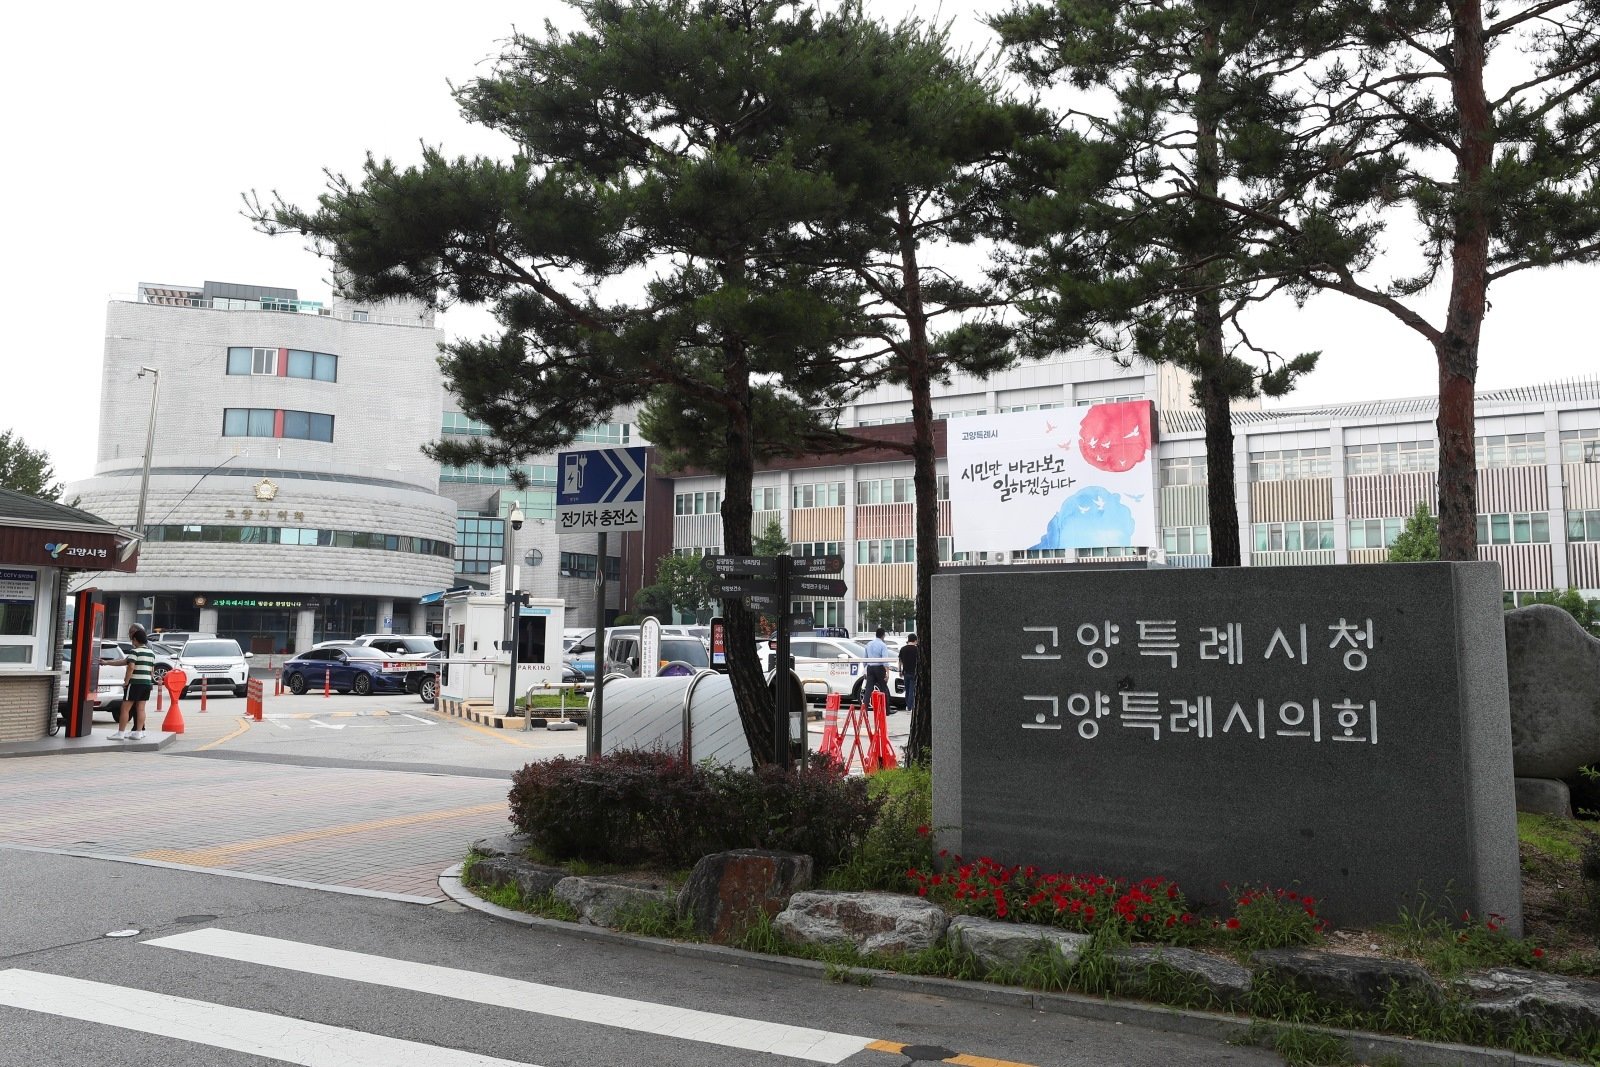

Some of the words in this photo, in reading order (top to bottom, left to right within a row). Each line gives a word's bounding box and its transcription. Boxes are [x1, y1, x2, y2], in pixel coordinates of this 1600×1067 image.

[961, 429, 998, 441] 고양특례시
[961, 460, 1003, 482] 시민만
[1008, 454, 1066, 474] 바라보고
[993, 473, 1077, 503] 일하겠습니다
[560, 509, 598, 528] 전기차
[600, 508, 639, 527] 충전소
[66, 547, 108, 558] 고양시청
[212, 599, 256, 607] 고양특례시의회
[1021, 617, 1374, 671] 고양특례시청
[1021, 690, 1378, 744] 고양특례시의회
